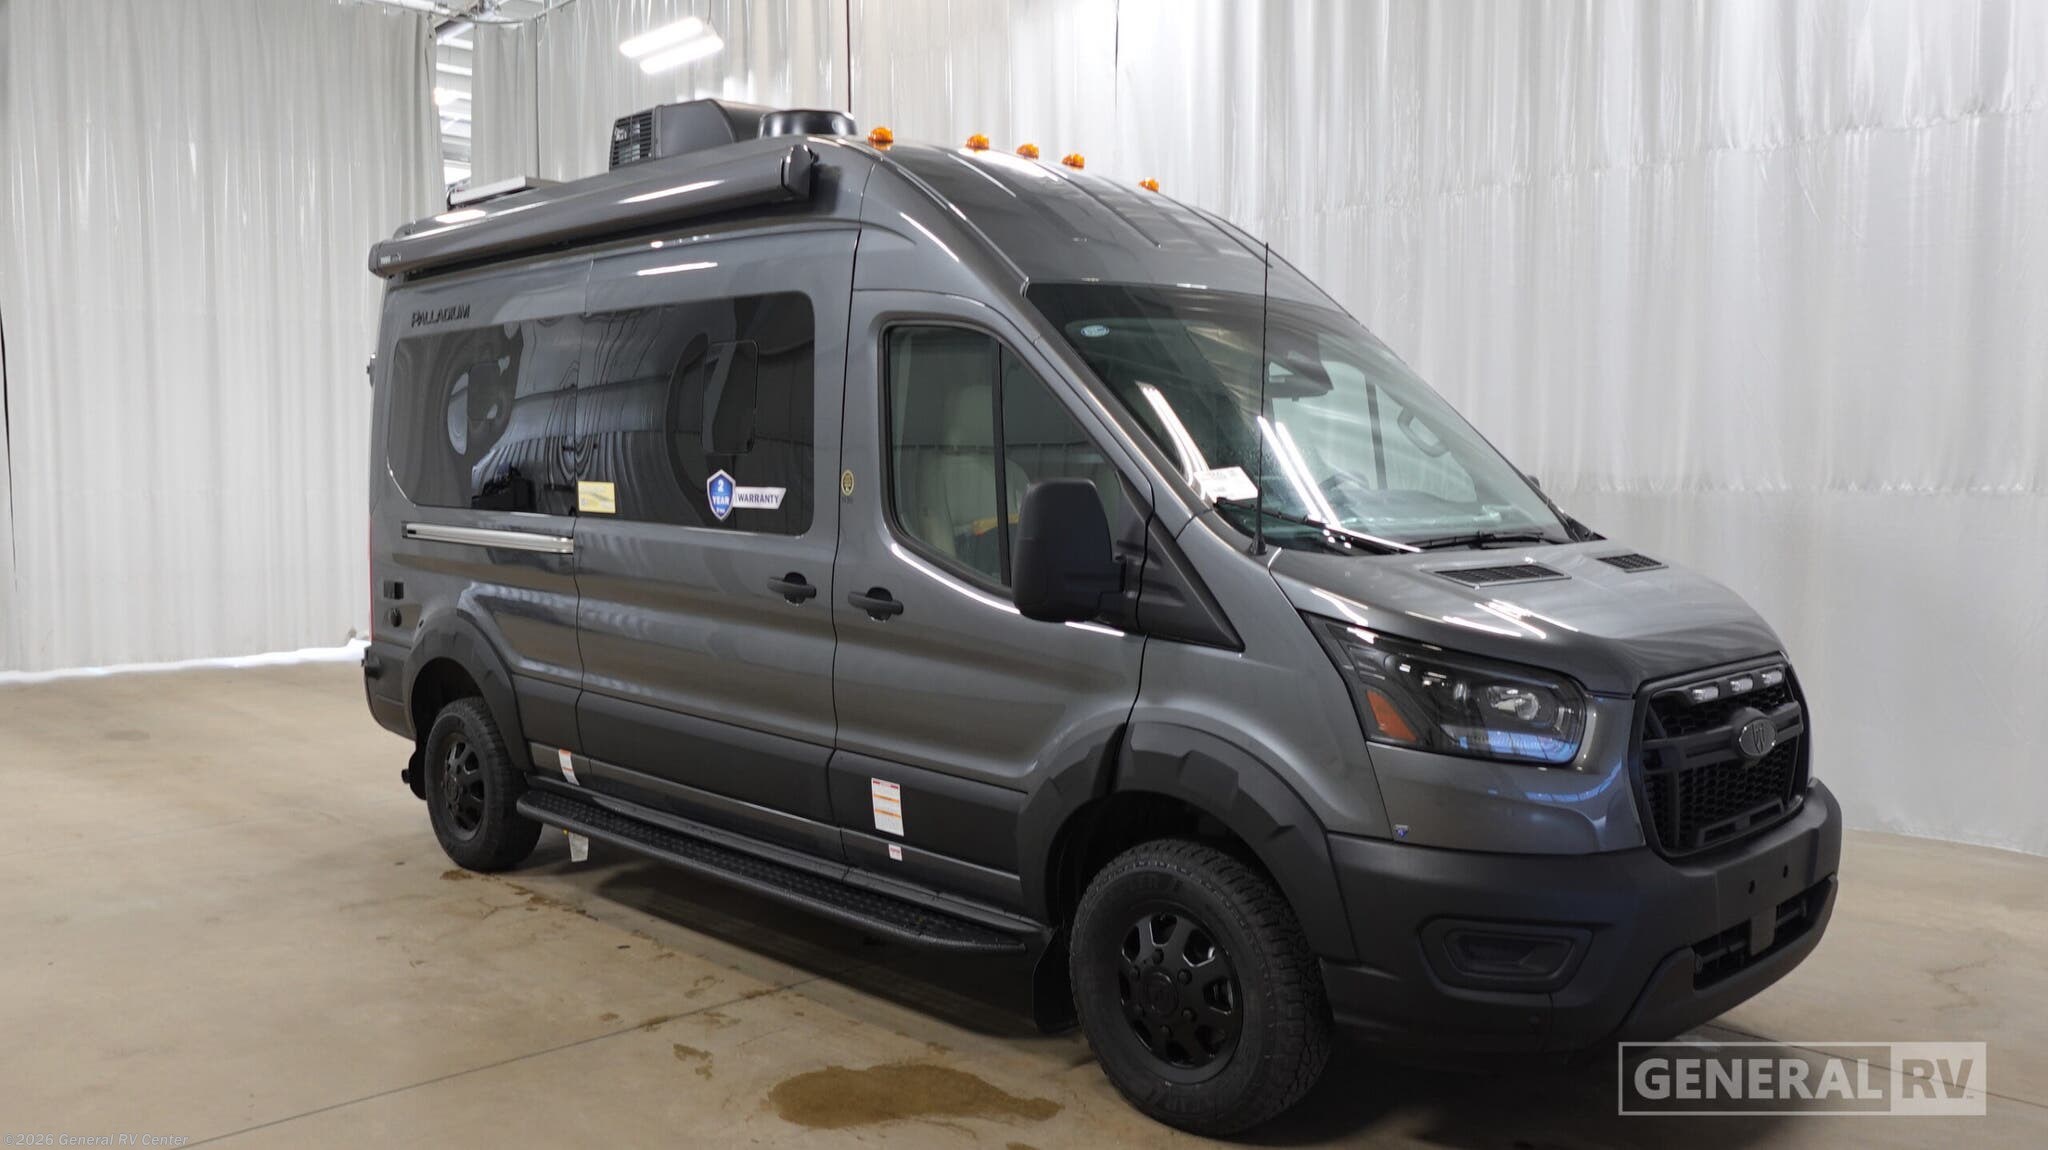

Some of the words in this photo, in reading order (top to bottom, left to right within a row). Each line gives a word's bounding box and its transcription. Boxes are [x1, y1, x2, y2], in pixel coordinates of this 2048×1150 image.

[411, 304, 470, 328] PALLADIUM
[717, 479, 725, 492] 2
[712, 495, 730, 505] YEAR
[737, 493, 780, 504] WARRANTY
